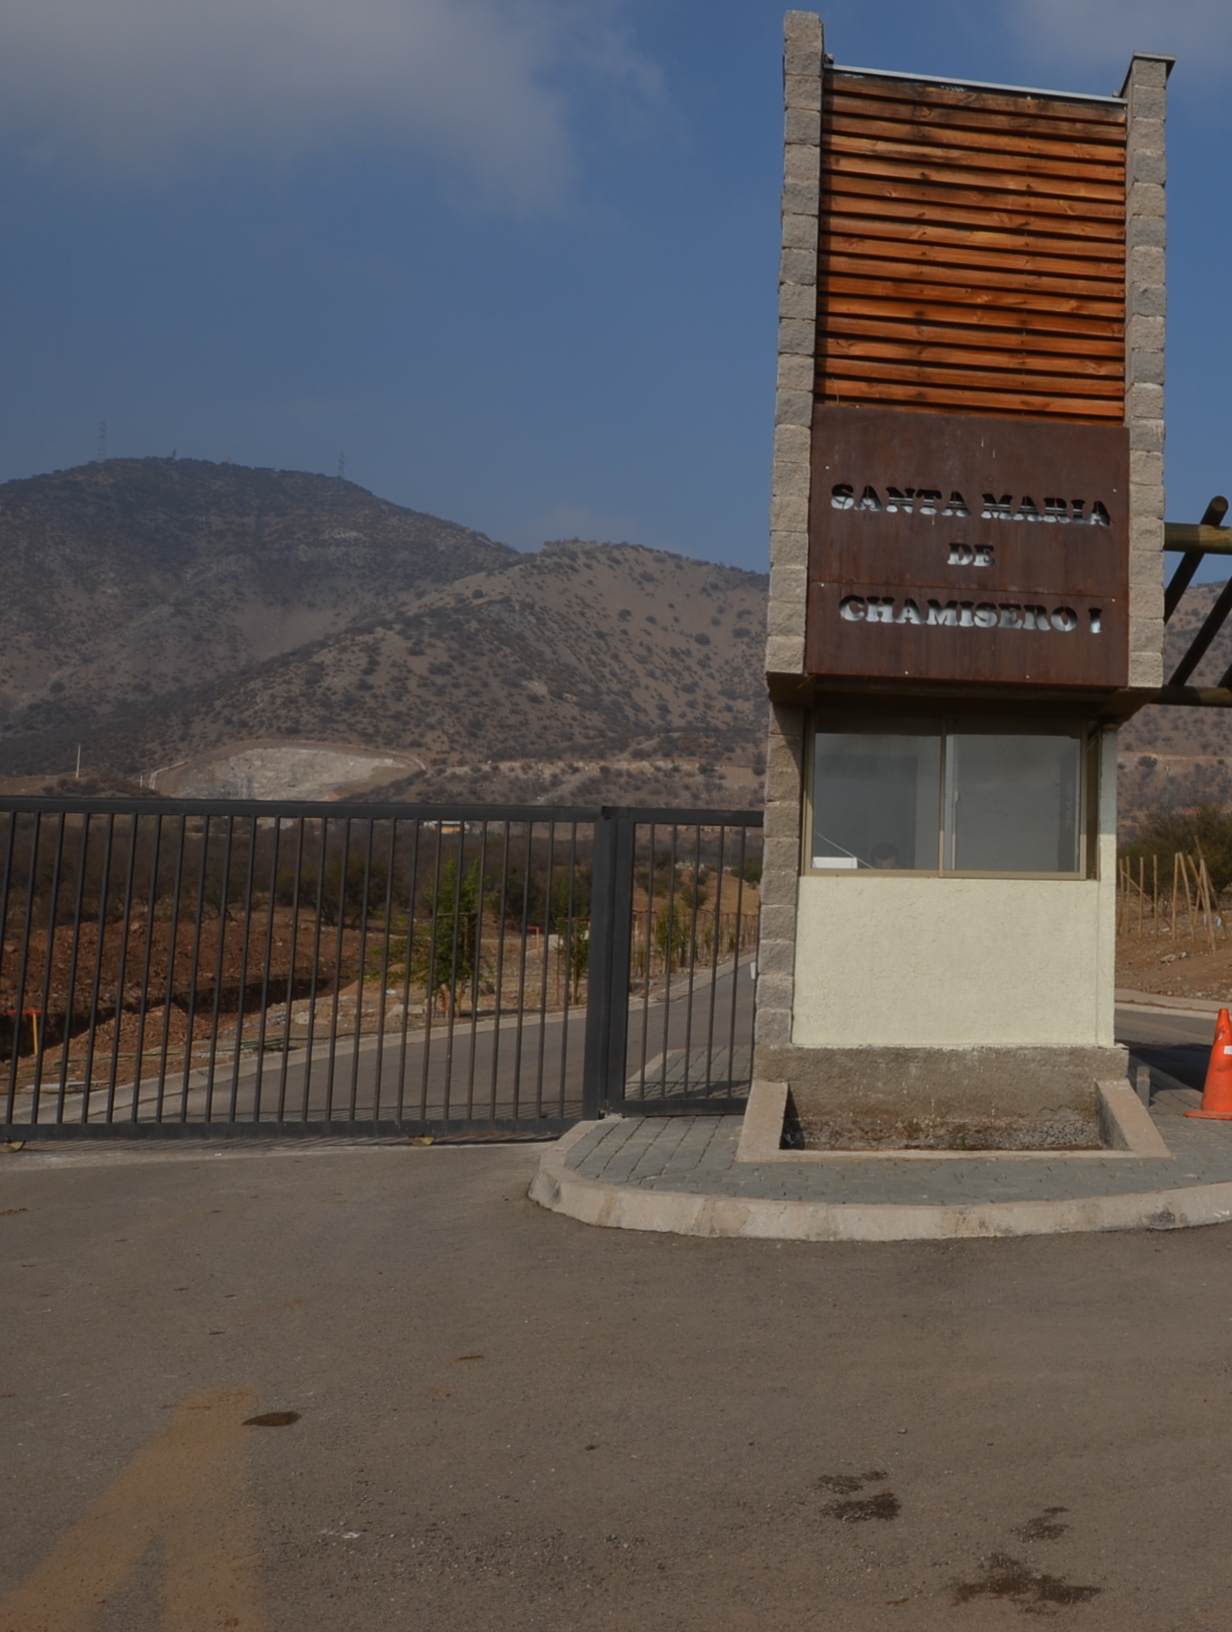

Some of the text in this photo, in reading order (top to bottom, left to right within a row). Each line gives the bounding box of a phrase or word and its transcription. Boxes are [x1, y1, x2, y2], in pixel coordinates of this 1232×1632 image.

[830, 483, 1111, 526] SANTA MARIA
[947, 542, 996, 567] DE
[839, 594, 1103, 634] CHAMISERO I
